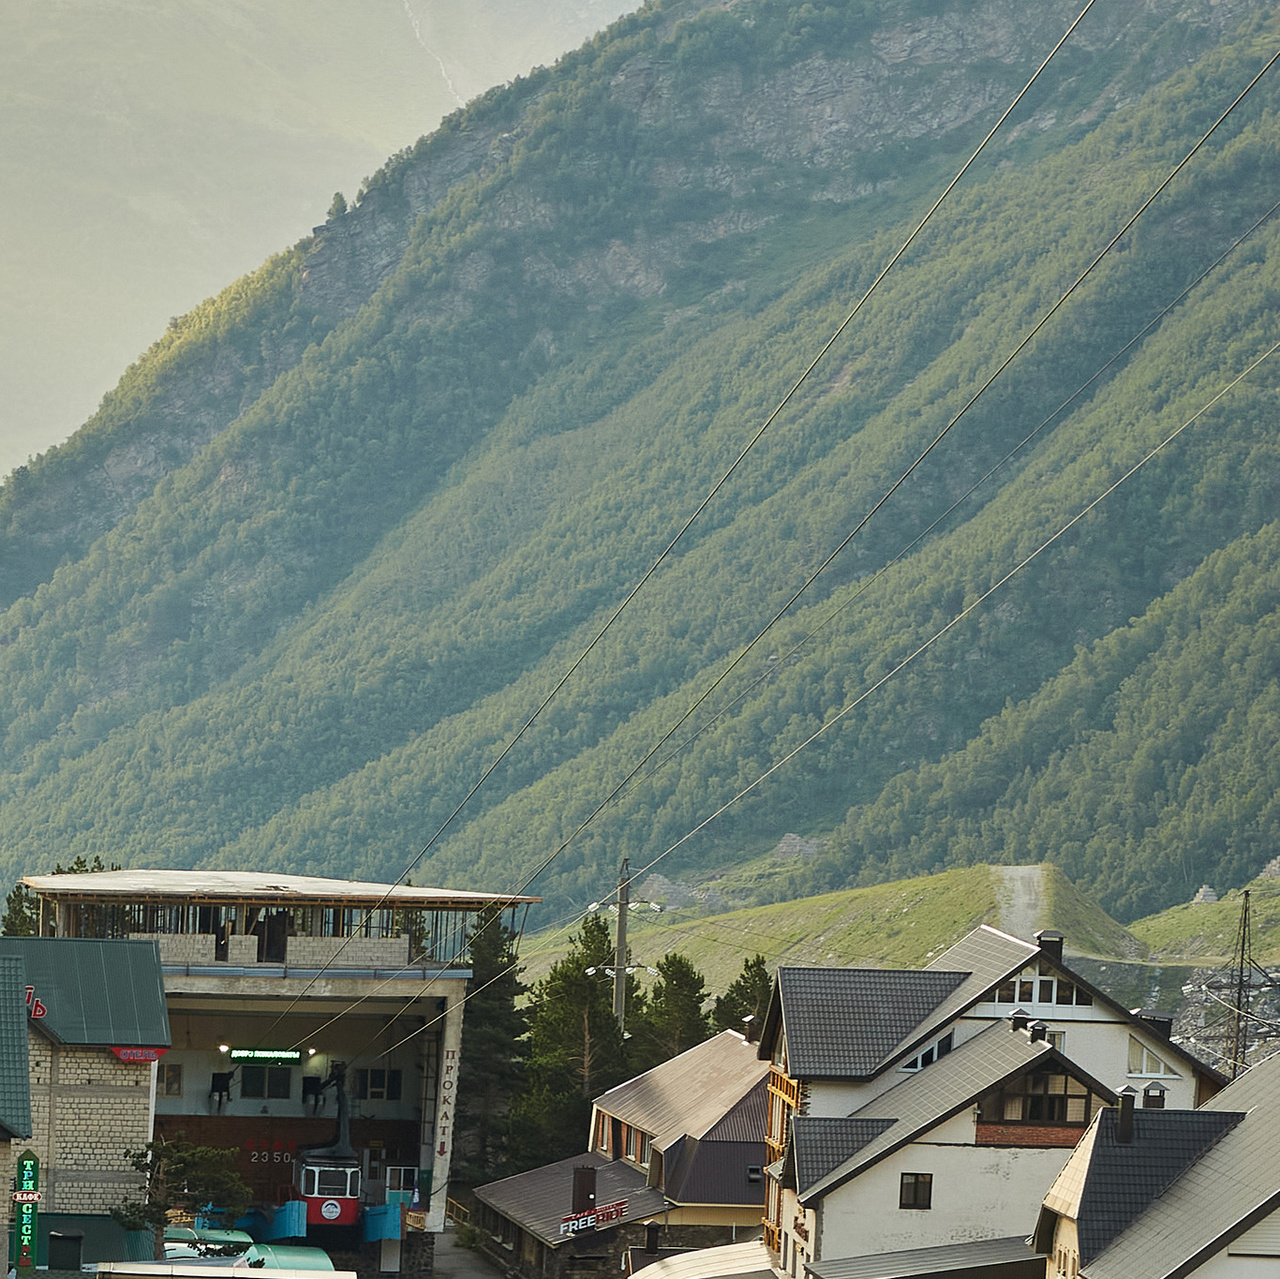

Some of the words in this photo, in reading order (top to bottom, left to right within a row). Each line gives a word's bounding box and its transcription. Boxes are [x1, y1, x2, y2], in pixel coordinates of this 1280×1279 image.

[120, 1050, 158, 1060] ОТЕЛЬ
[439, 1050, 456, 1136] ПРОКАТ
[251, 1152, 291, 1163] 2350
[16, 1193, 38, 1201] КАФЕ
